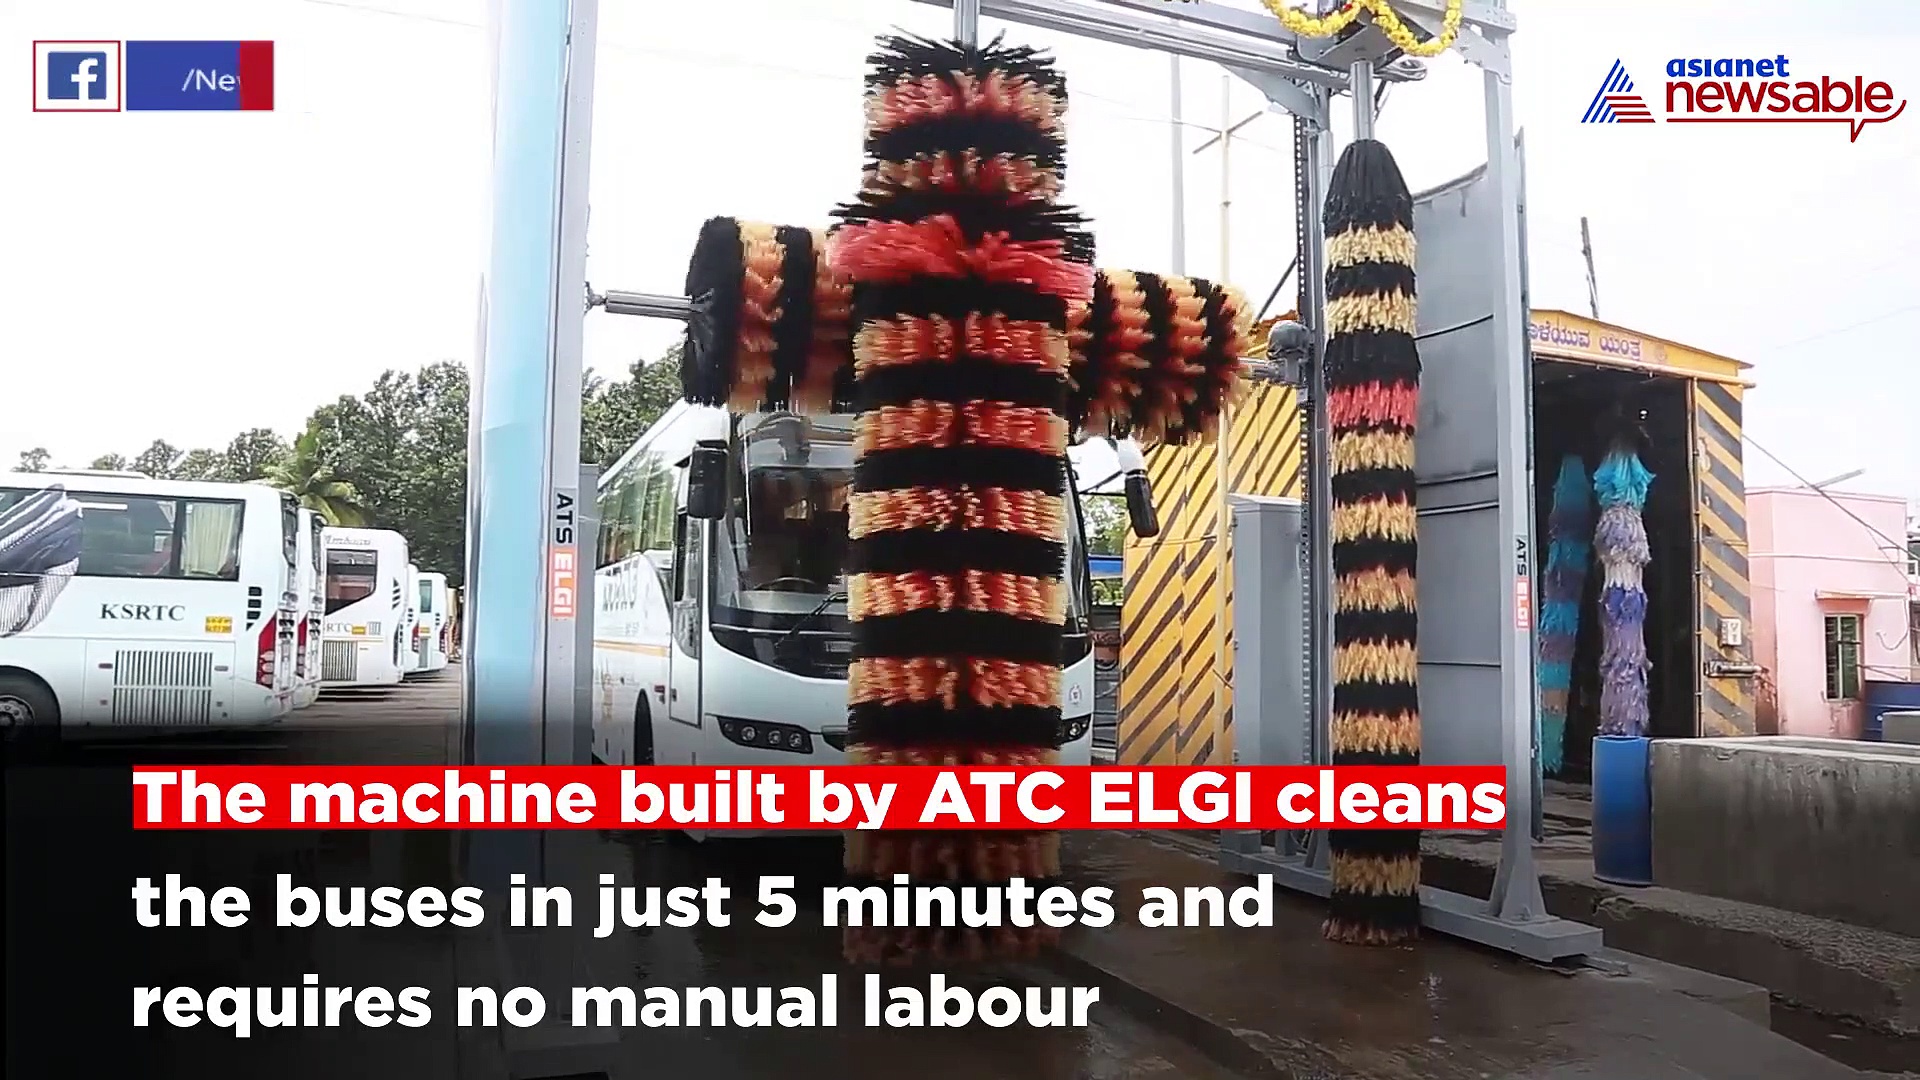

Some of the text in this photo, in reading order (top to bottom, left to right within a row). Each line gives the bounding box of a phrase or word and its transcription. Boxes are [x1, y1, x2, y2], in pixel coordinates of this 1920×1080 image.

[553, 493, 574, 614] ATS ELGI
[1517, 538, 1528, 575] ATS
[100, 603, 186, 622] KSRTC
[323, 622, 352, 633] RTC
